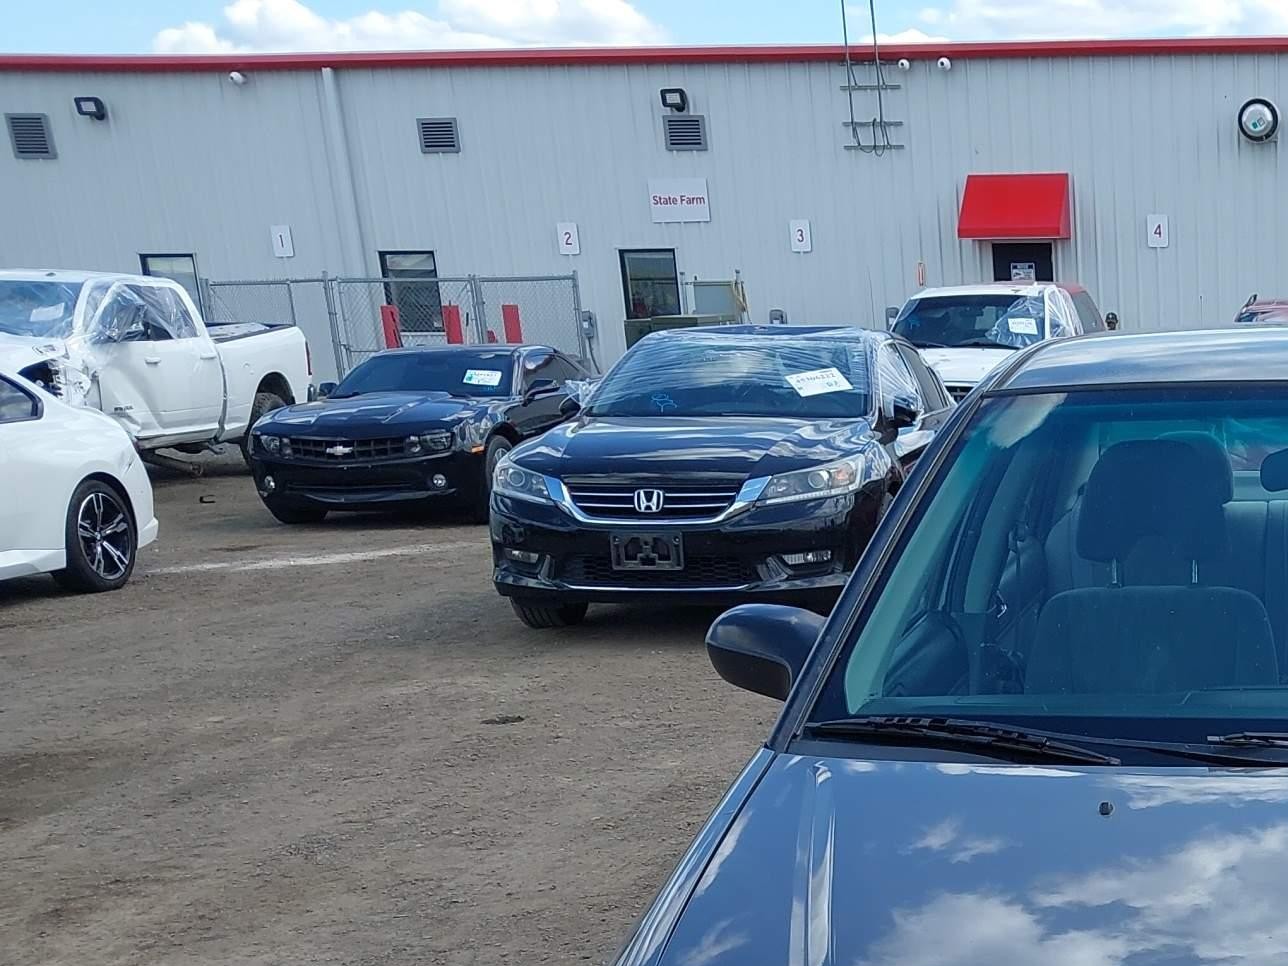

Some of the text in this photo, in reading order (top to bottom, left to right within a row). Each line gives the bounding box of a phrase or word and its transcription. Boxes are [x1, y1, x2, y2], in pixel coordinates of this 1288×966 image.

[652, 194, 706, 205] State Farm
[796, 228, 805, 242] 3
[1153, 223, 1162, 238] 4
[278, 234, 285, 248] 1
[564, 231, 573, 246] 2
